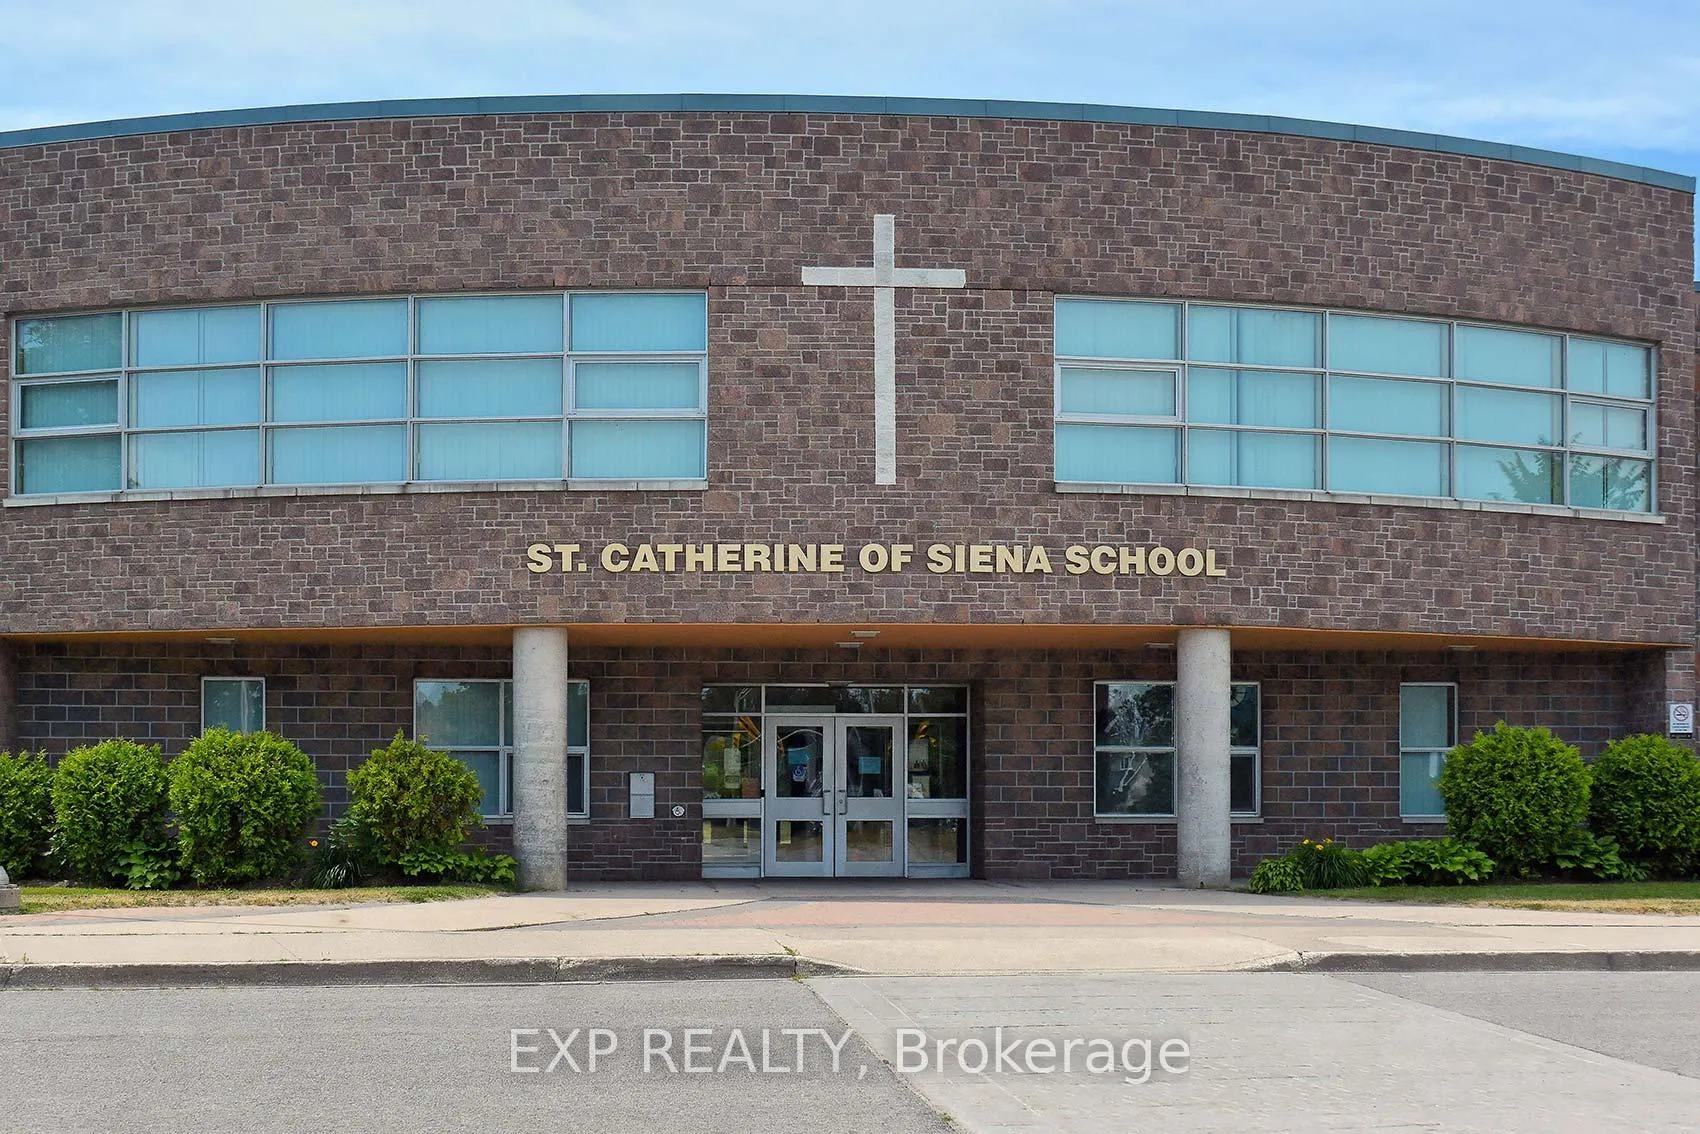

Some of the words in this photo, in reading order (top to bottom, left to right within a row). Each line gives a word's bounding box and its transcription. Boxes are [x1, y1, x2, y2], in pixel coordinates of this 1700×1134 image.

[526, 543, 587, 573] ST.
[601, 543, 845, 573] CATHERINE
[859, 544, 914, 573] OF
[926, 544, 1053, 574] SIENA
[1065, 546, 1227, 576] SCHOOL
